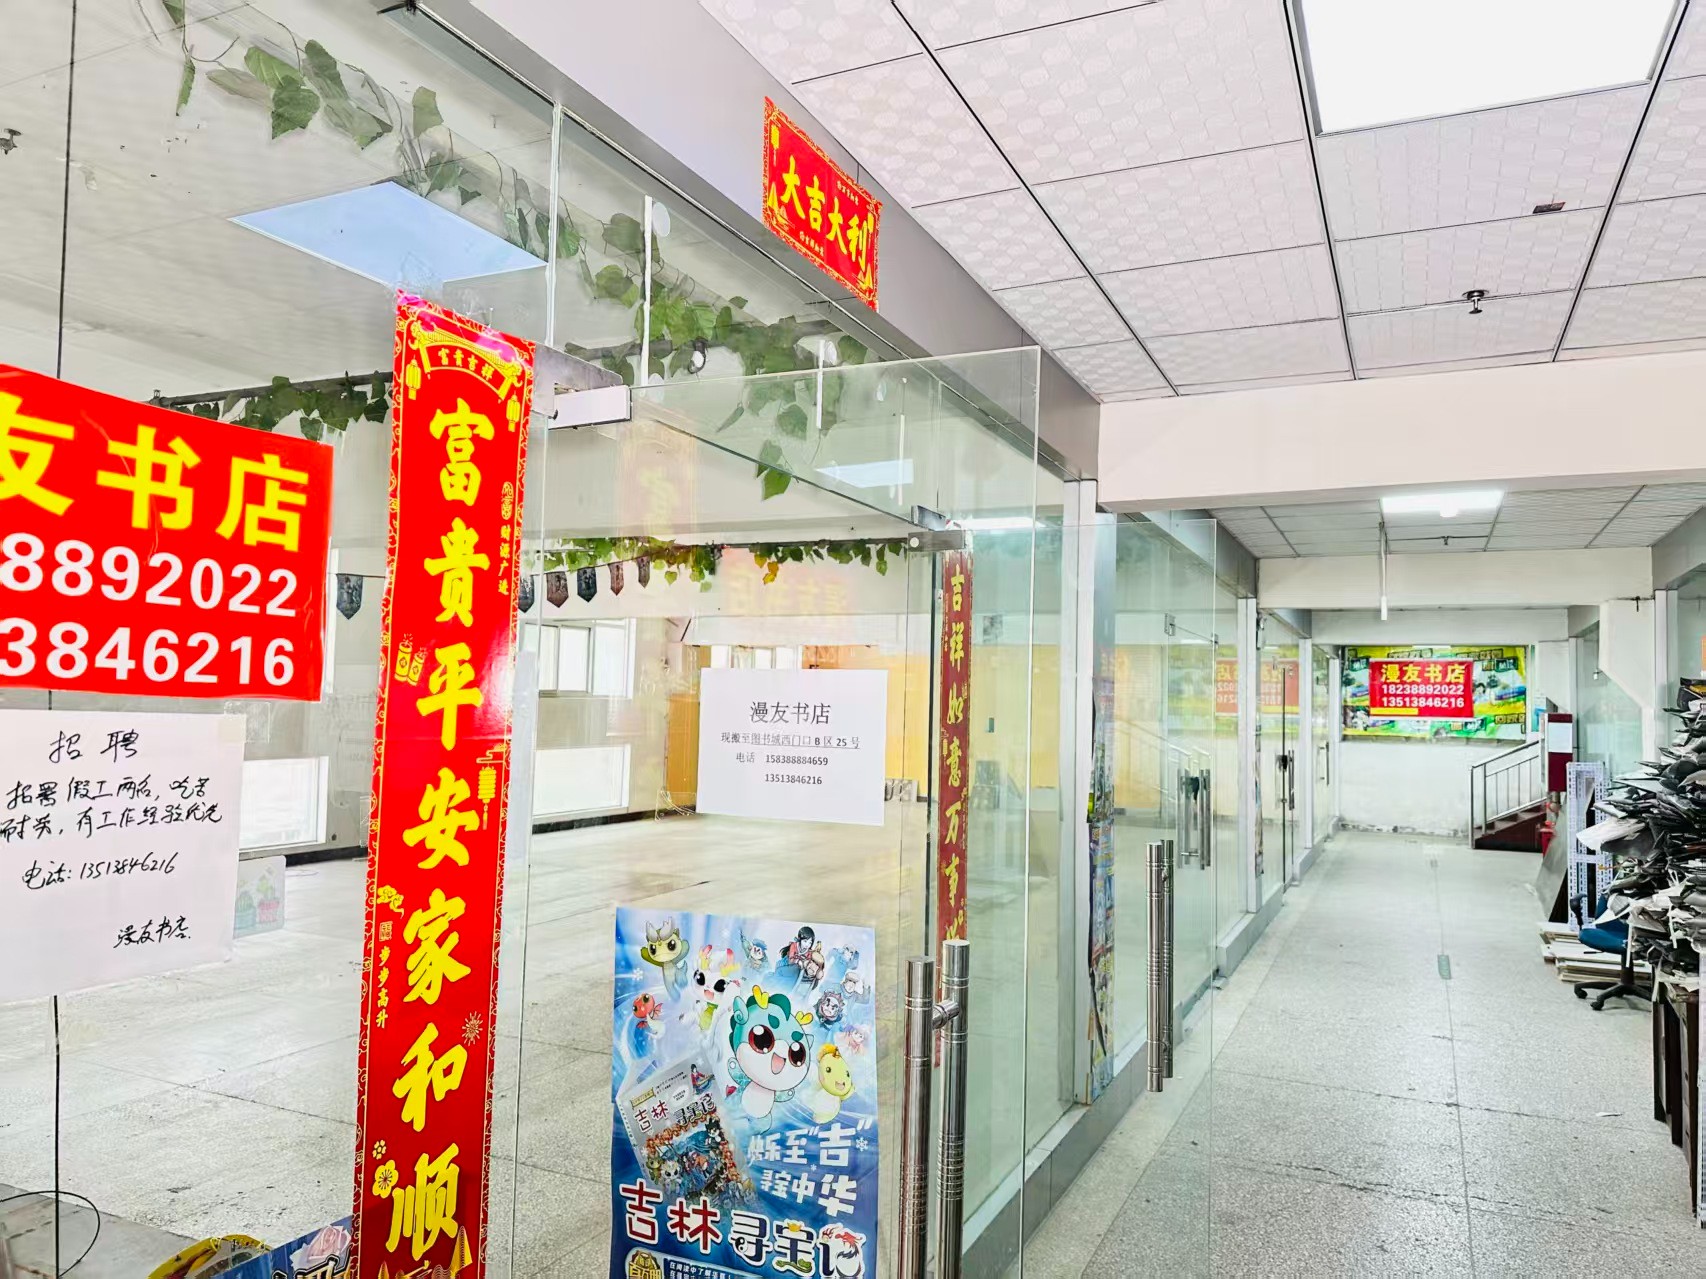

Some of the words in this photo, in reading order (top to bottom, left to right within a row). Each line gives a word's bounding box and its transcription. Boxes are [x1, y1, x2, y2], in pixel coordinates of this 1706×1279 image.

[781, 155, 868, 271] 大吉大利
[0, 391, 309, 552] 友书店
[0, 532, 298, 617] 8892022
[0, 617, 295, 686] 3846216
[1380, 663, 1466, 683] 漫友书店
[1381, 684, 1465, 695] 18238892022
[750, 701, 832, 724] 漫友书店
[1381, 696, 1465, 708] 13513846216
[48, 728, 140, 763] 招聘
[736, 751, 756, 763] 电话
[764, 773, 823, 785] 13513846216
[386, 397, 495, 1261] 富贵平安家和顺
[760, 1169, 857, 1217] 寻宝中华
[619, 1179, 867, 1279] 吉林寻宝记
